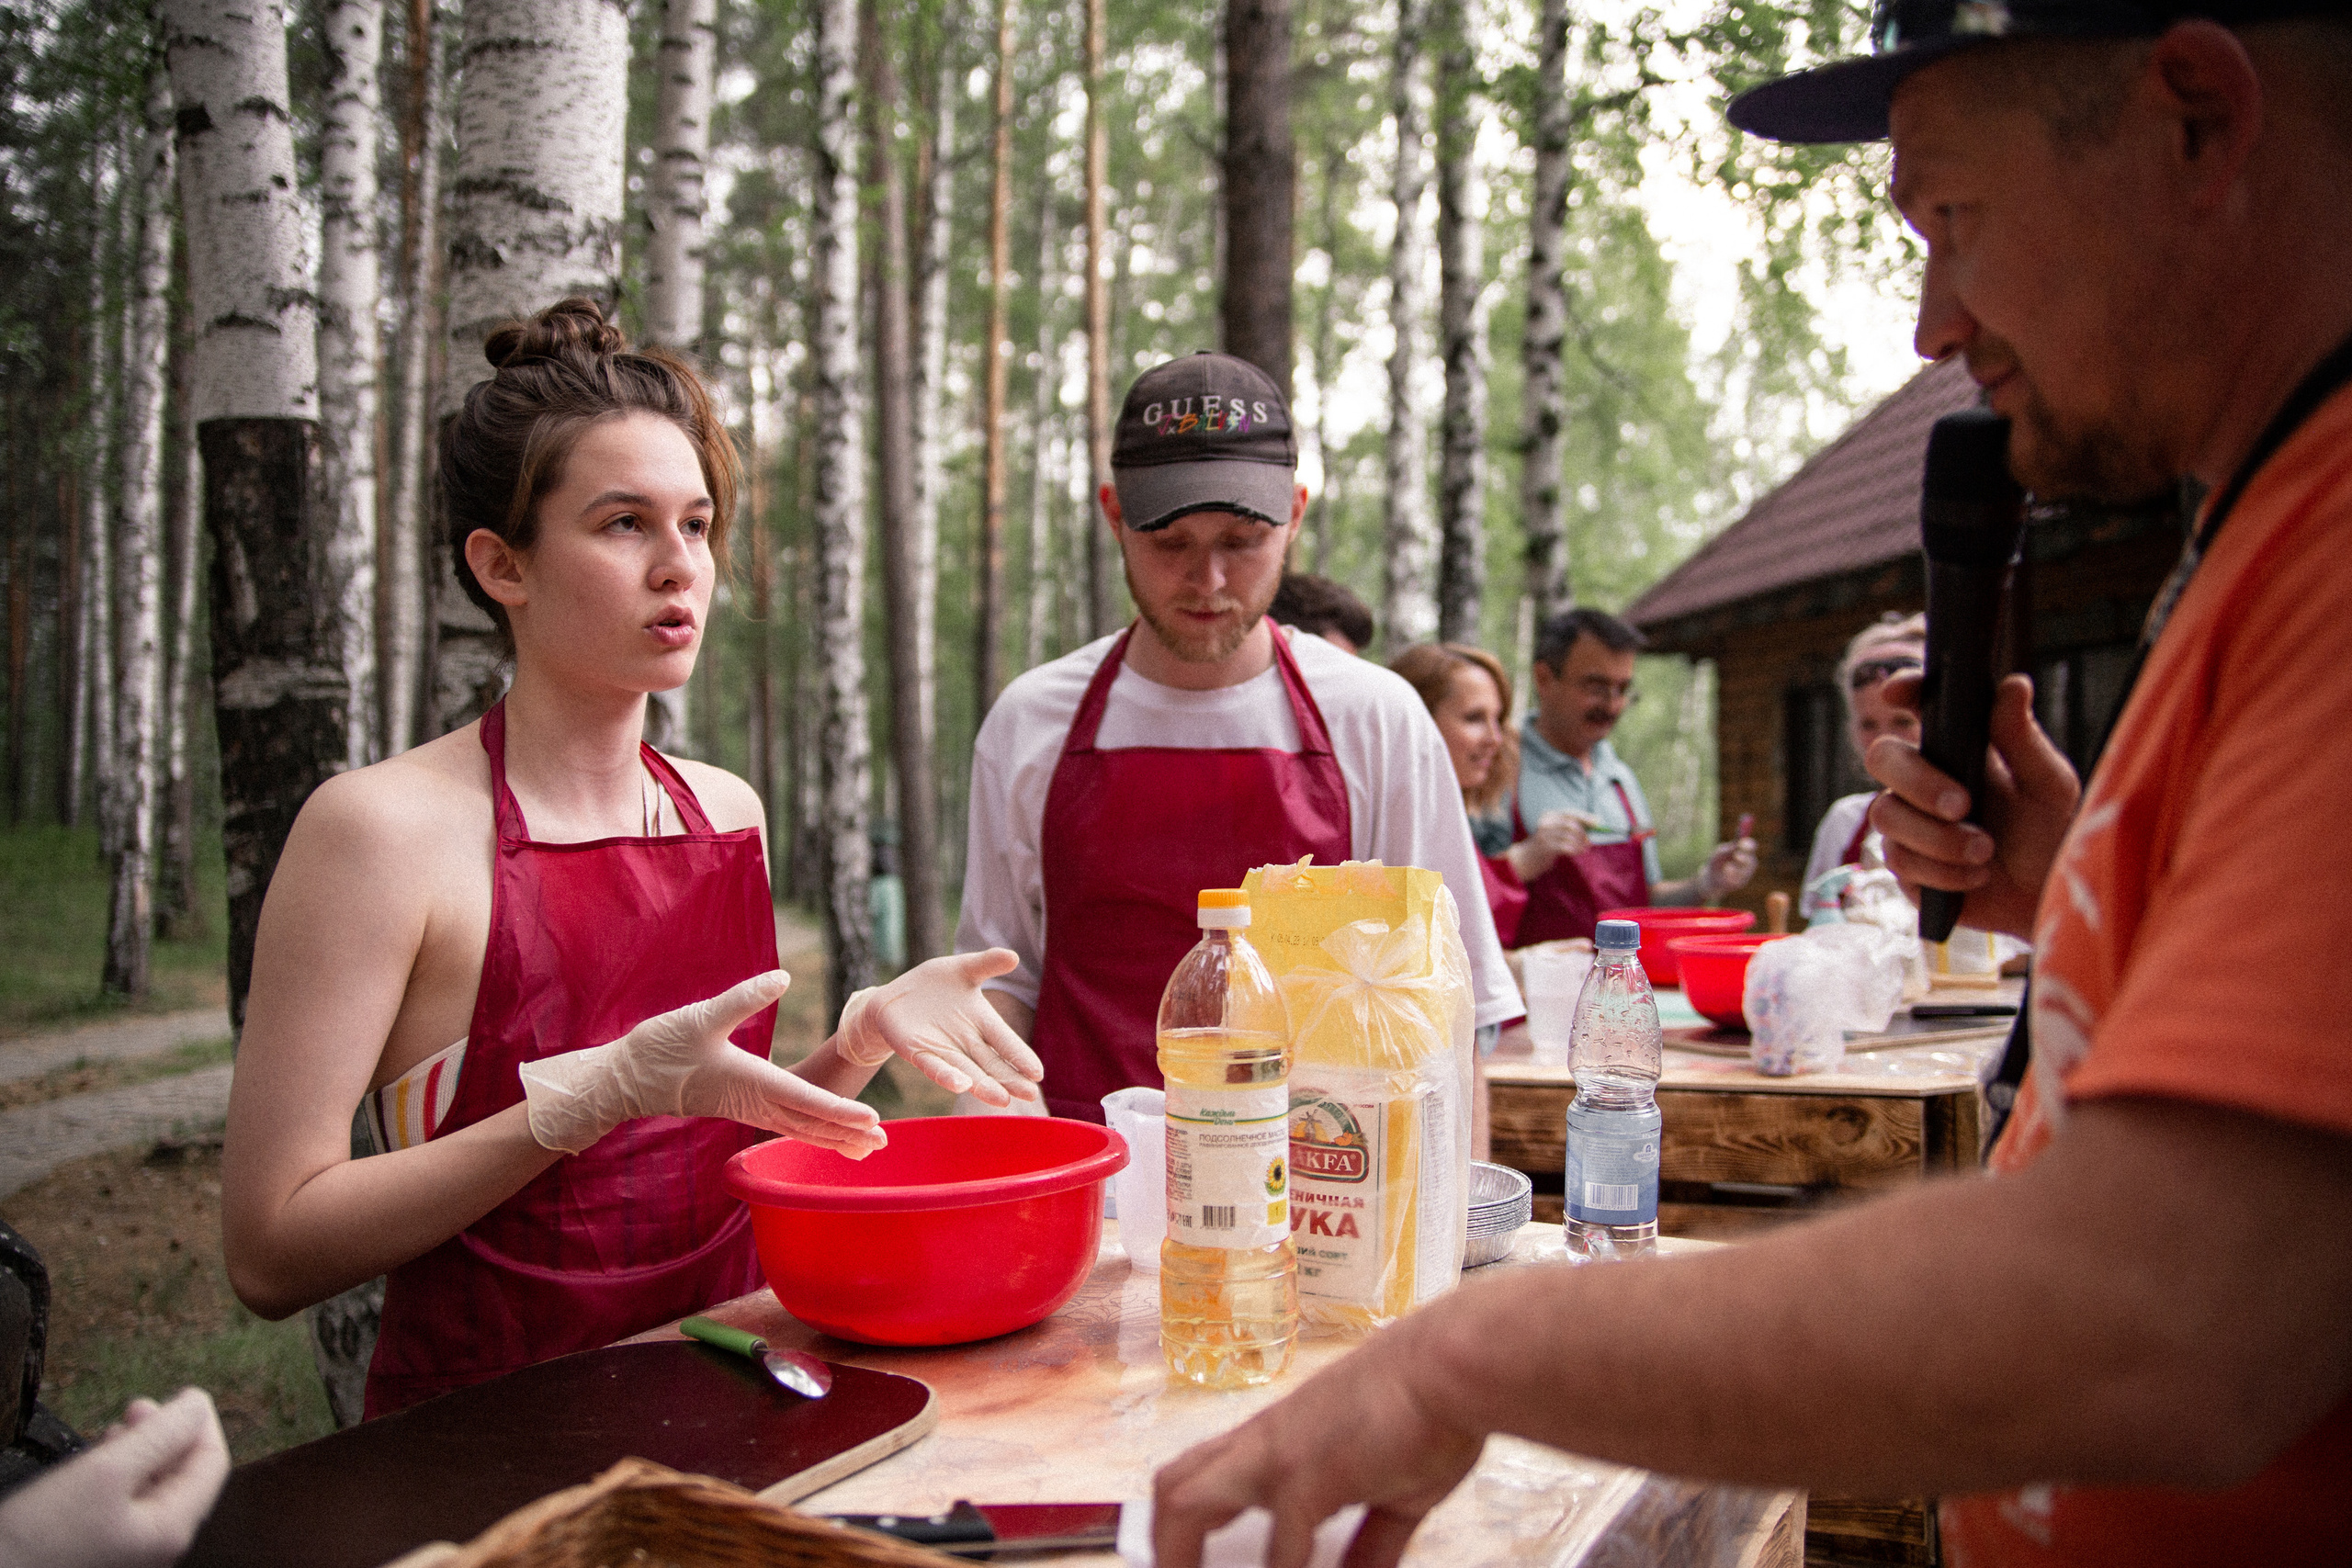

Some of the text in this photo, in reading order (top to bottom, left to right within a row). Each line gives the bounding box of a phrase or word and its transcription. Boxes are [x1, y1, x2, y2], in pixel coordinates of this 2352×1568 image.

[1143, 395, 1268, 425] GUESS
[1199, 1133, 1267, 1144] ПОДСОЛНЕЧНОЕ
[1290, 1147, 1354, 1173] AKFA
[1290, 1188, 1364, 1209] ЕНИЧНАЯ
[1290, 1205, 1361, 1239] УКА
